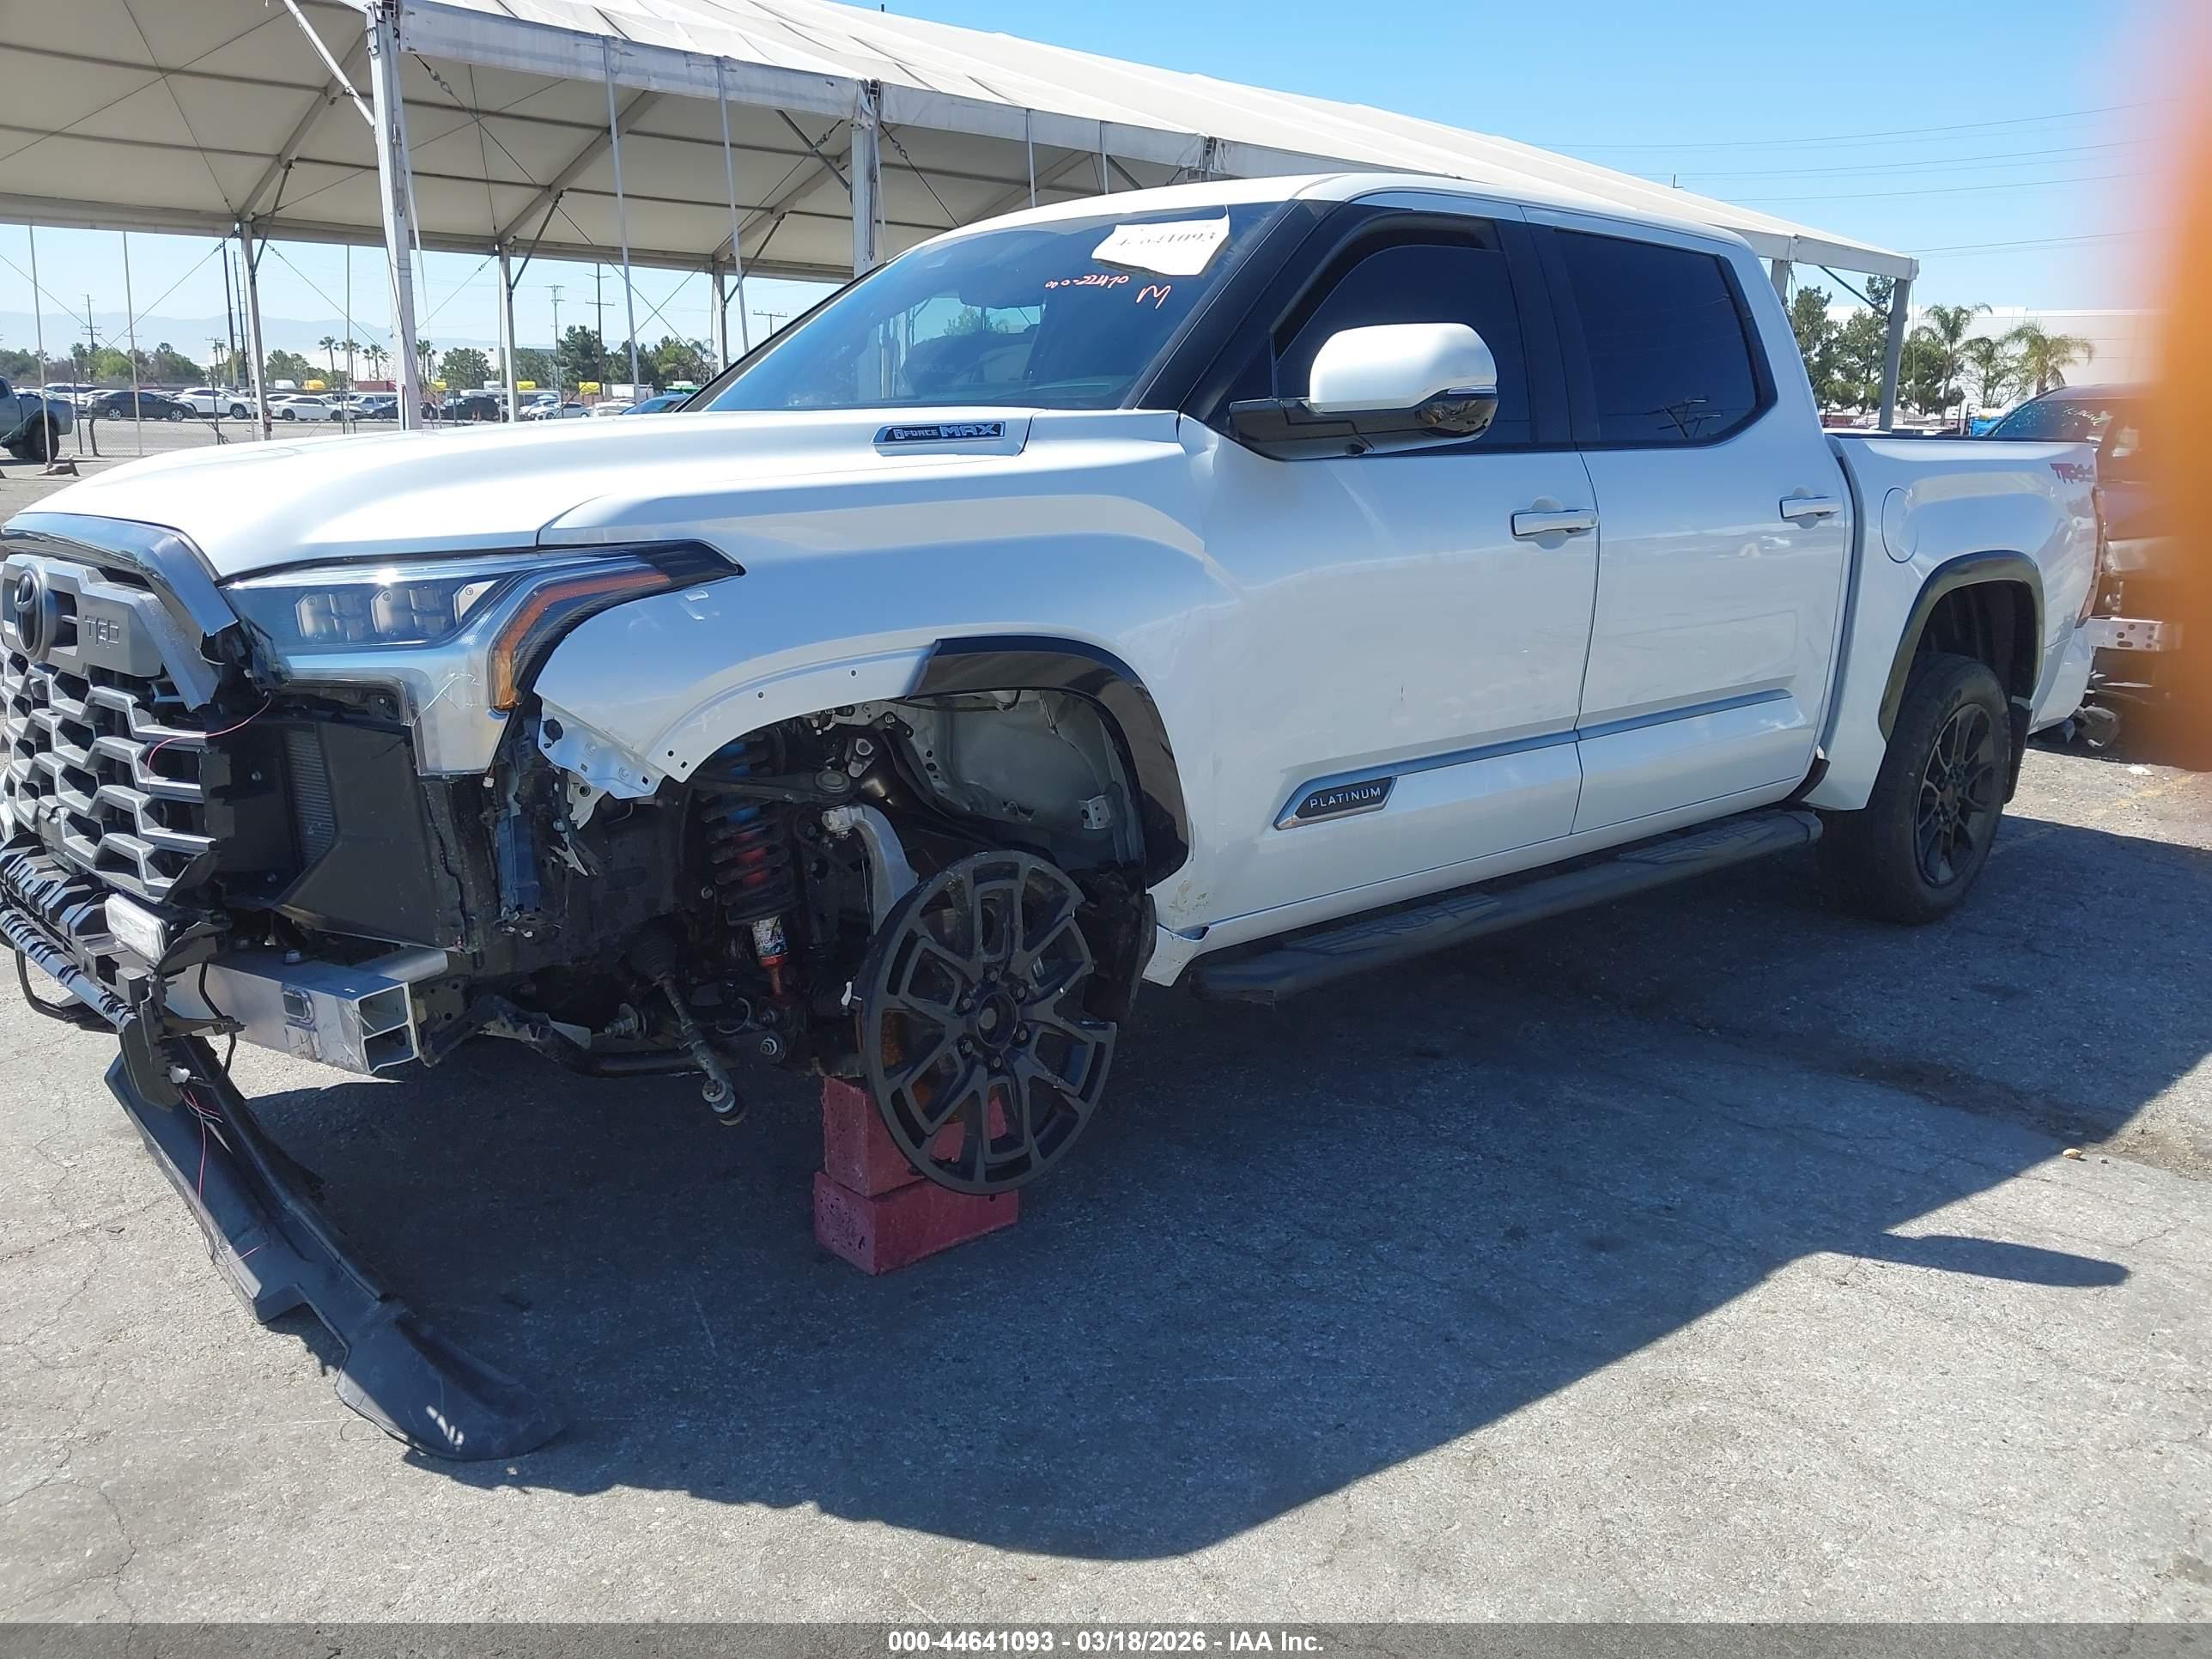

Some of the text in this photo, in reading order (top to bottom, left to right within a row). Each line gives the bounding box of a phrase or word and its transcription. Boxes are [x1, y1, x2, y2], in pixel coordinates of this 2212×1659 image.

[1135, 284, 1172, 310] M
[939, 424, 999, 438] MAX
[1310, 786, 1382, 810] PLATINUM
